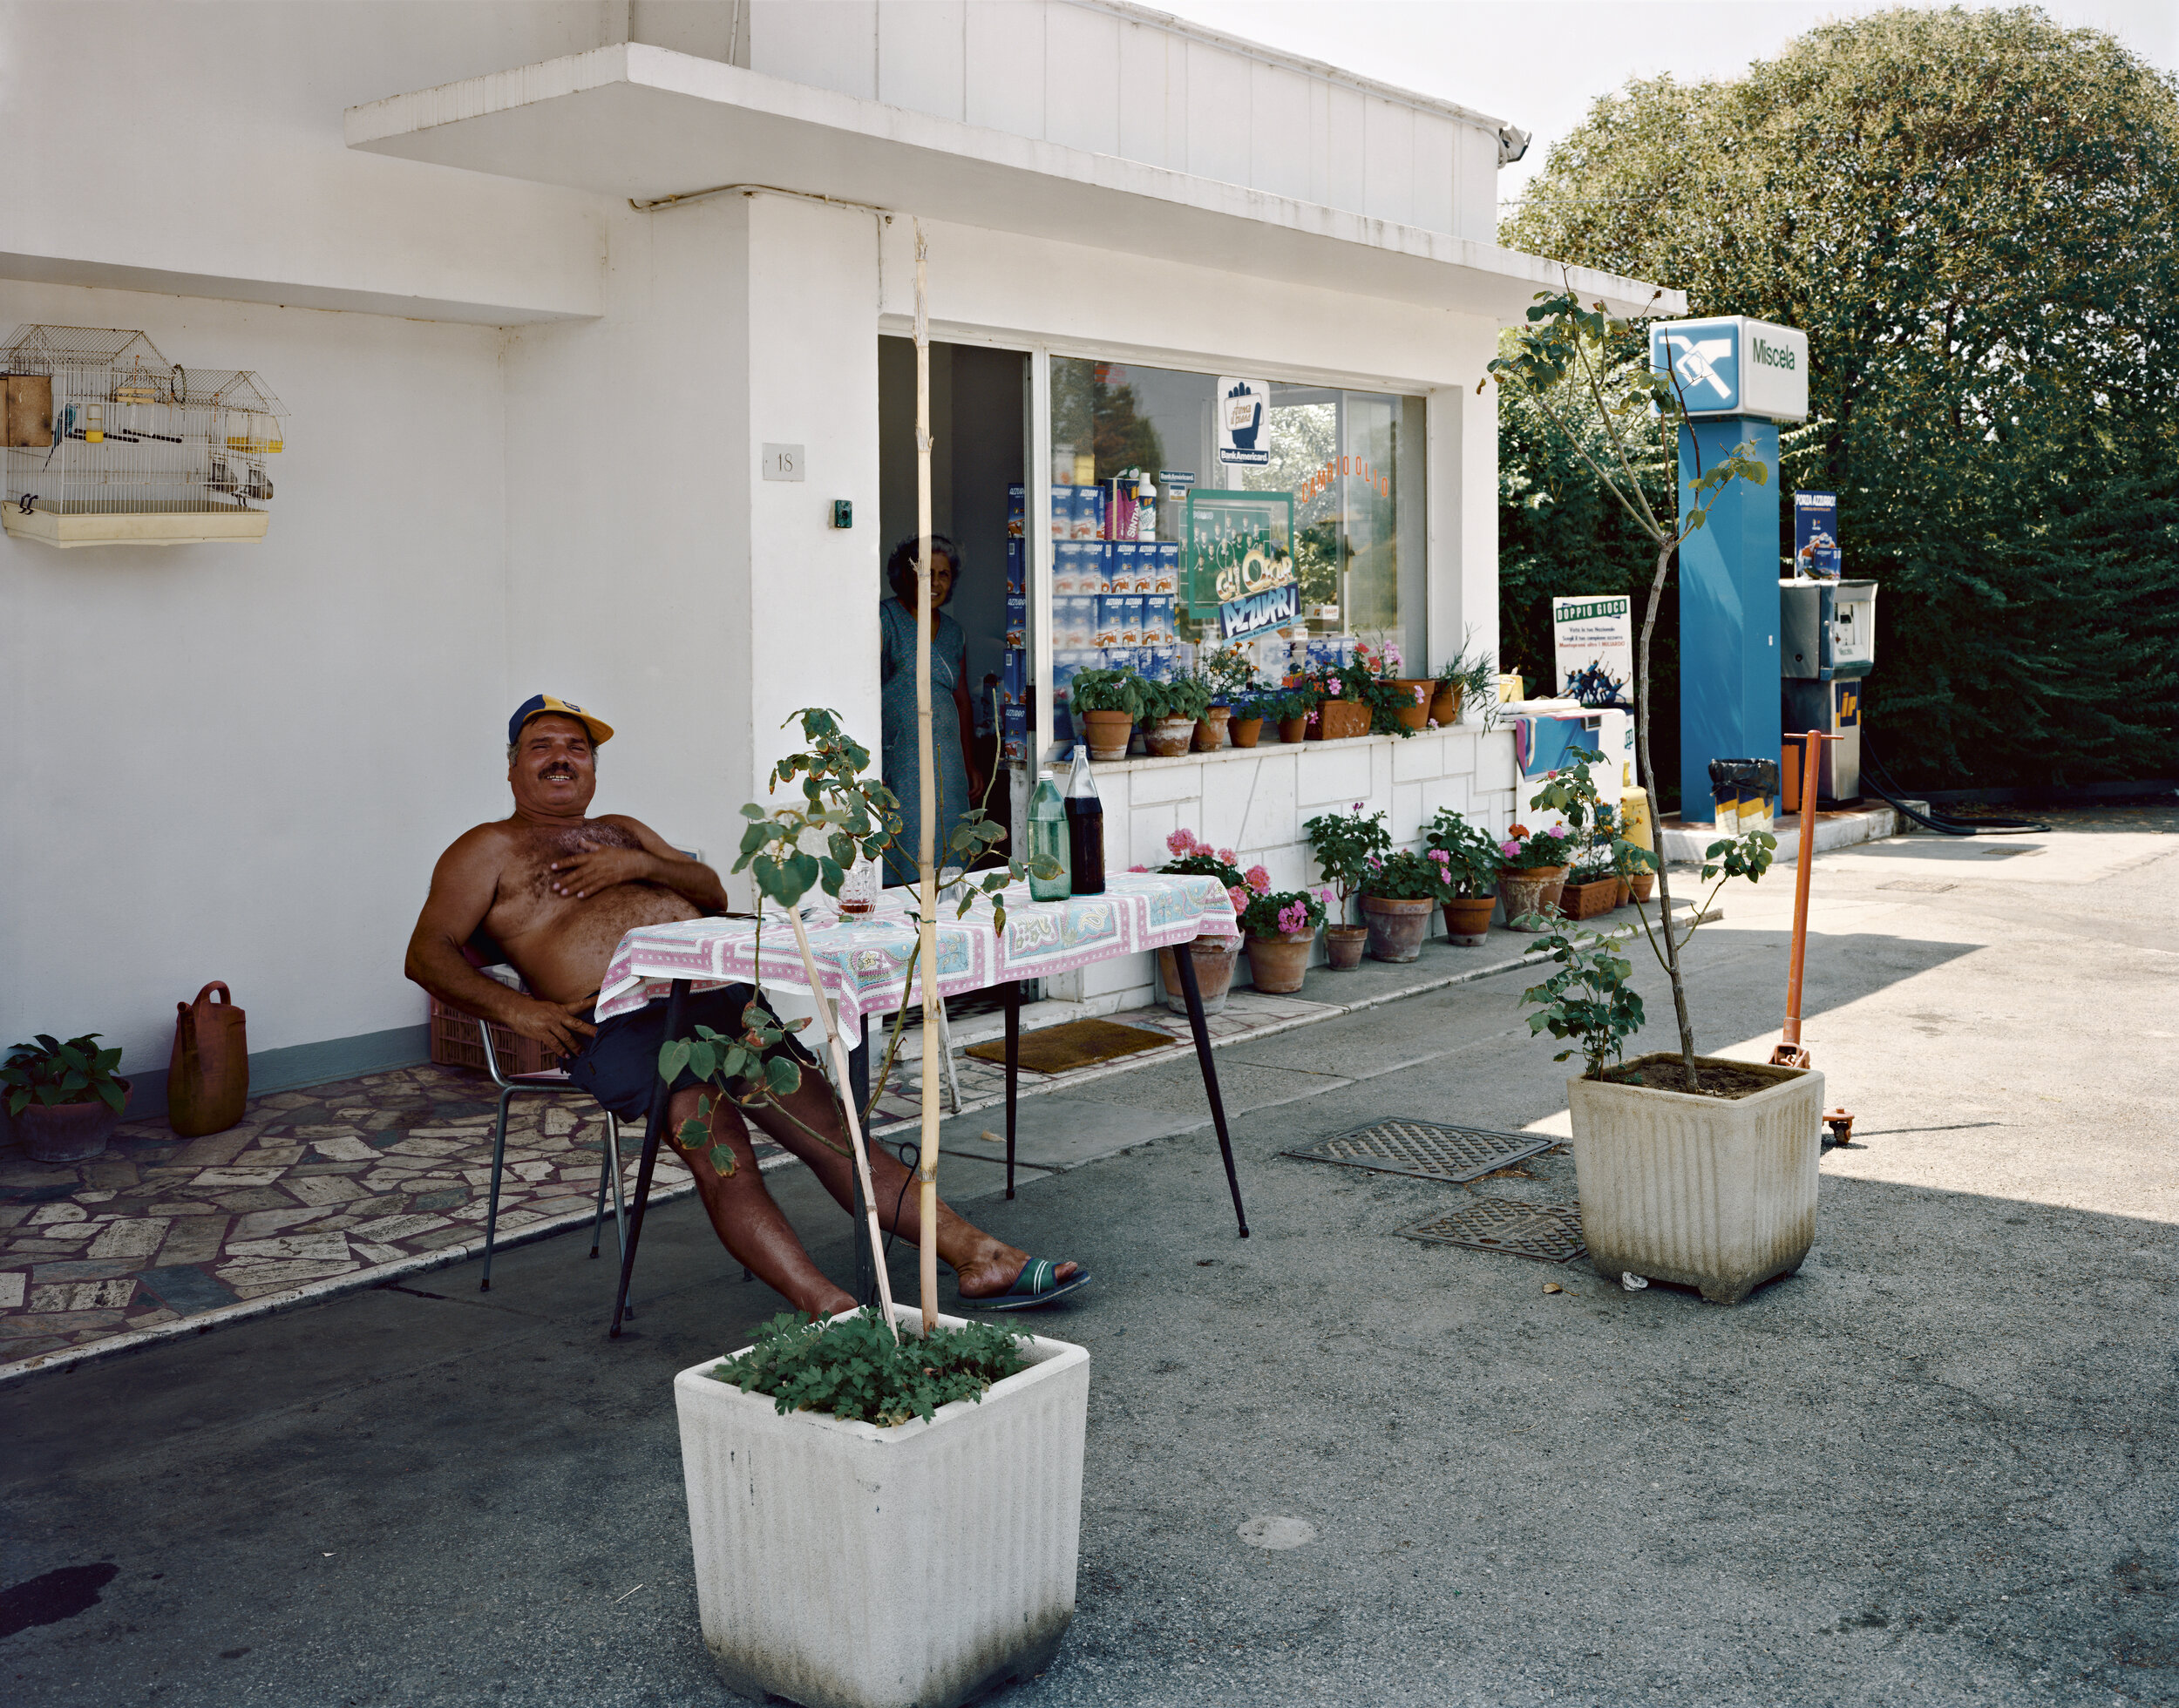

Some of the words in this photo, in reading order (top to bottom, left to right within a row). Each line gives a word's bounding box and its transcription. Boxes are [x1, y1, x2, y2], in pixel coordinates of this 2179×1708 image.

[1753, 337, 1795, 370] Miscela
[778, 453, 793, 471] 18
[1302, 456, 1349, 503] CAMBIO
[1355, 456, 1388, 498] OLIO
[1222, 586, 1296, 638] AZZURRI
[1558, 605, 1592, 621] DOPPIO
[1597, 600, 1625, 615] GIOCO
